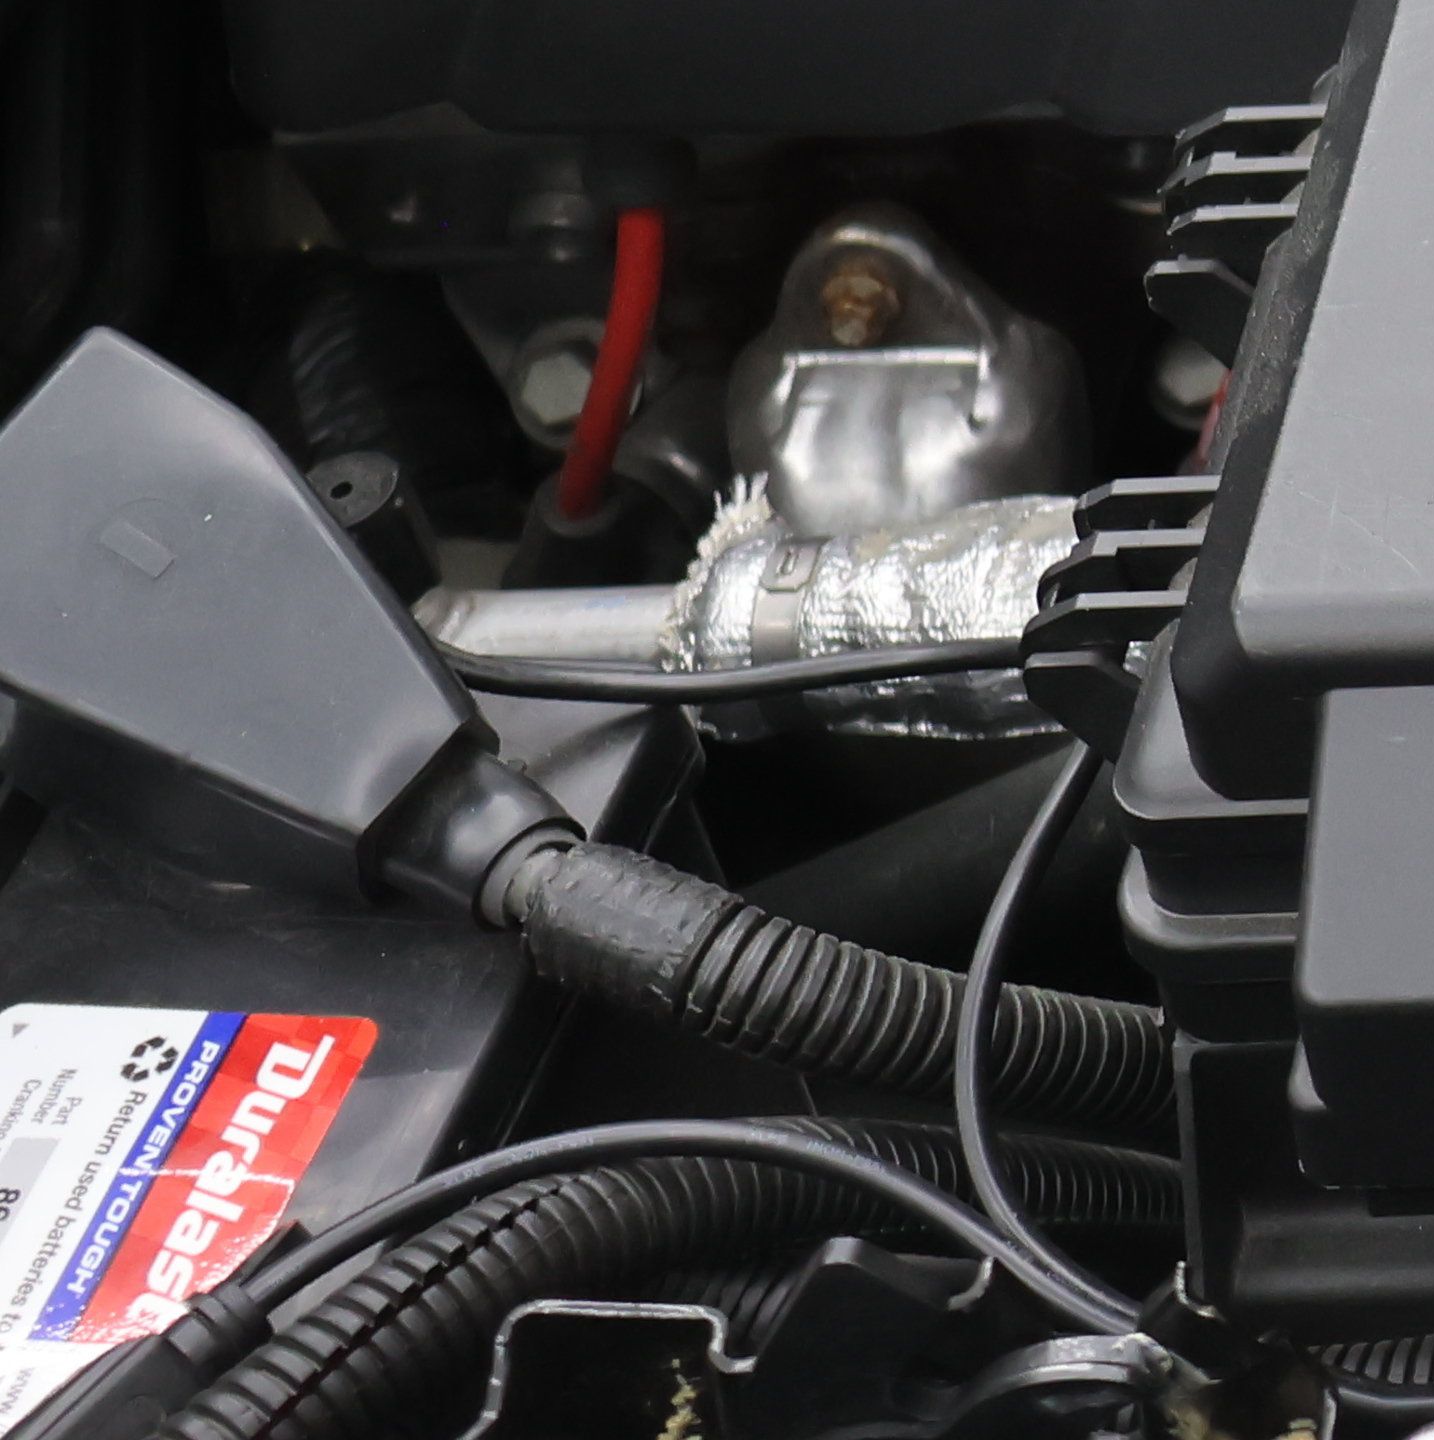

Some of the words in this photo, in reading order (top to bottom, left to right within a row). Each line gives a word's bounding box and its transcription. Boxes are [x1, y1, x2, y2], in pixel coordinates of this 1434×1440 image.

[94, 1091, 147, 1156] Return
[132, 1040, 220, 1171] PROVEN
[65, 1161, 101, 1211] used
[11, 1215, 77, 1306] batteries
[67, 1180, 142, 1294] TOUGH
